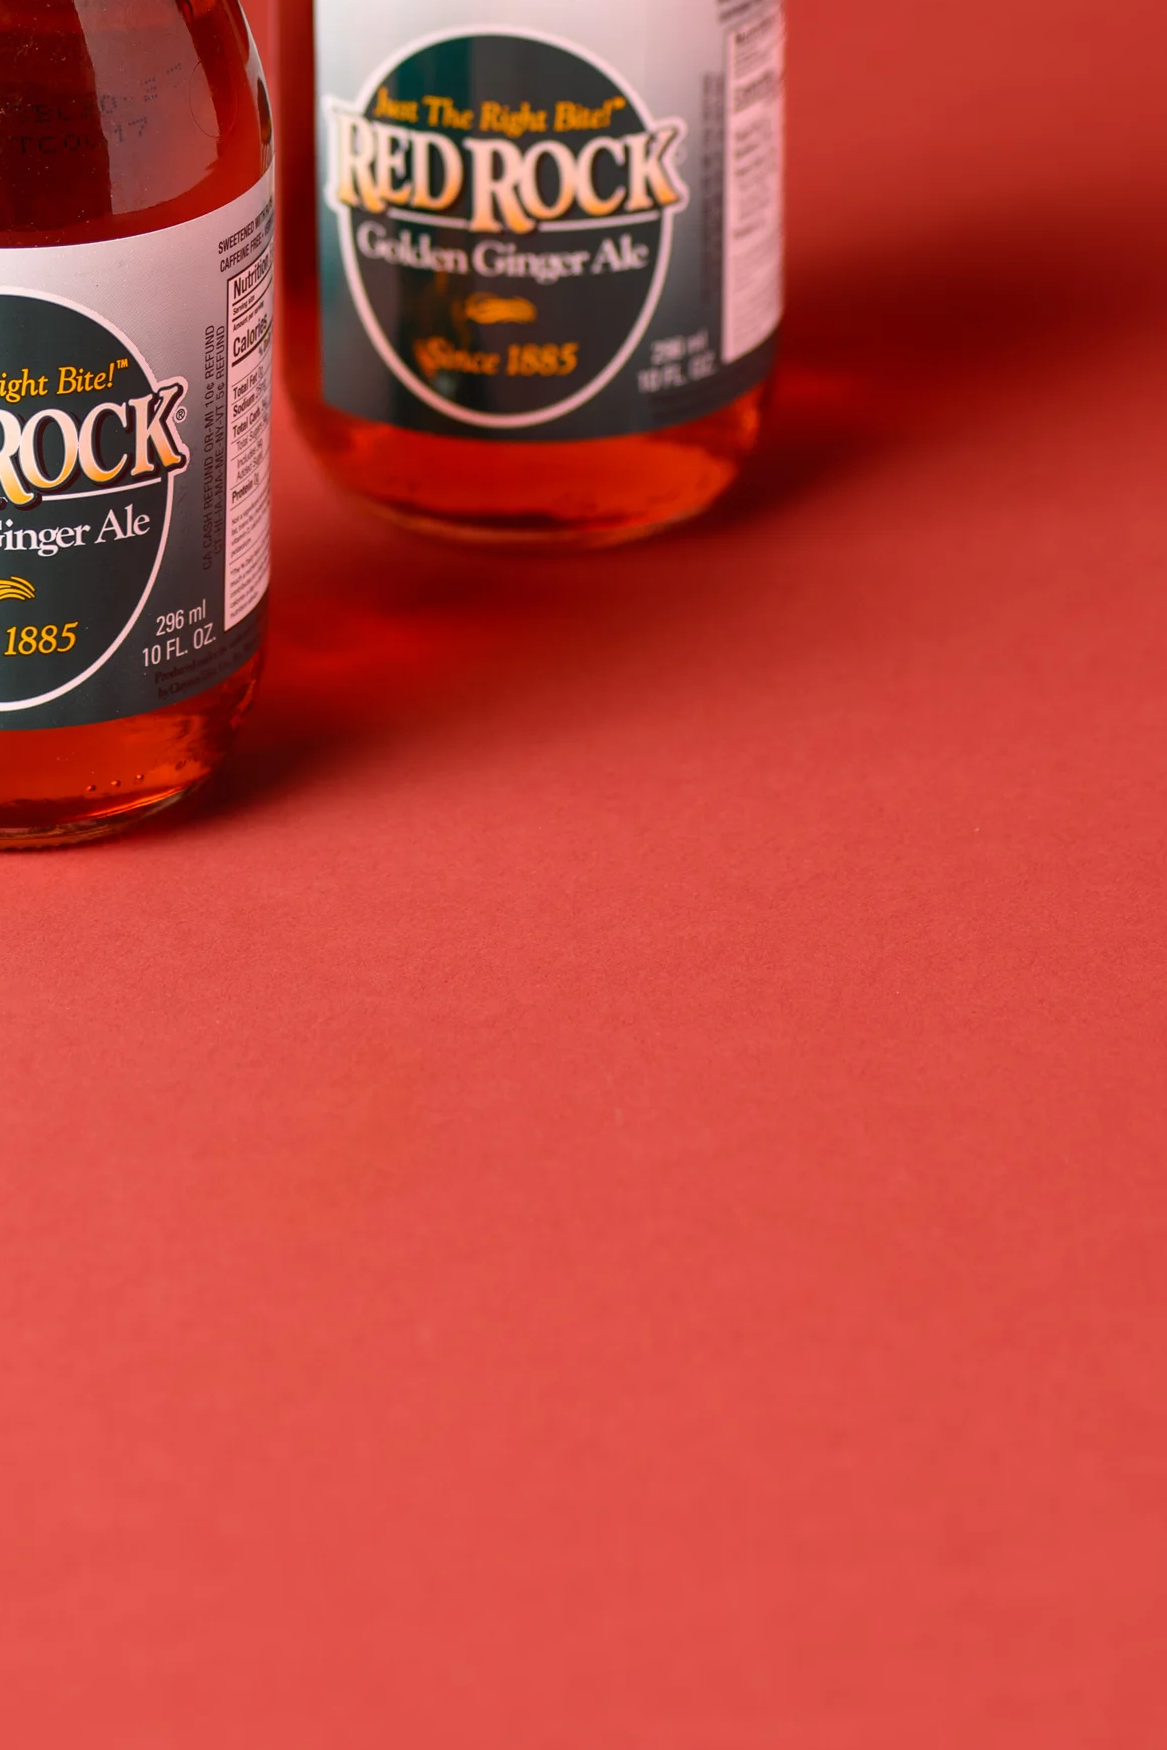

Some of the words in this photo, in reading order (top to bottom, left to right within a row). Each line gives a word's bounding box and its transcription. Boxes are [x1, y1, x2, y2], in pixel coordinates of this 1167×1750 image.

[373, 86, 418, 123] Just
[422, 95, 474, 130] The
[479, 100, 547, 138] Right
[334, 108, 464, 213] RED
[462, 127, 681, 234] ROCK
[218, 220, 255, 255] SWEETENED
[220, 243, 249, 273] CAFFEINE
[356, 220, 469, 274] Golden
[472, 238, 590, 285] Ginger
[591, 233, 649, 275] Ale
[233, 254, 268, 300] Nutrition
[204, 325, 215, 379] REFUND
[215, 325, 225, 380] REFUND
[233, 313, 268, 358] Calories
[425, 336, 500, 376] Since
[505, 342, 579, 377] 1885
[233, 379, 248, 400] Total
[204, 411, 214, 452] OR-MI
[232, 416, 248, 438] Total
[203, 456, 214, 508] REFUND
[94, 503, 151, 545] Ale
[202, 513, 213, 548] CASH
[202, 553, 212, 570] CA
[155, 608, 185, 636] 296
[188, 598, 206, 626] ml
[3, 620, 80, 656] 1885
[142, 644, 162, 667] 10
[166, 637, 188, 662] FL.
[193, 622, 217, 649] OZ.
